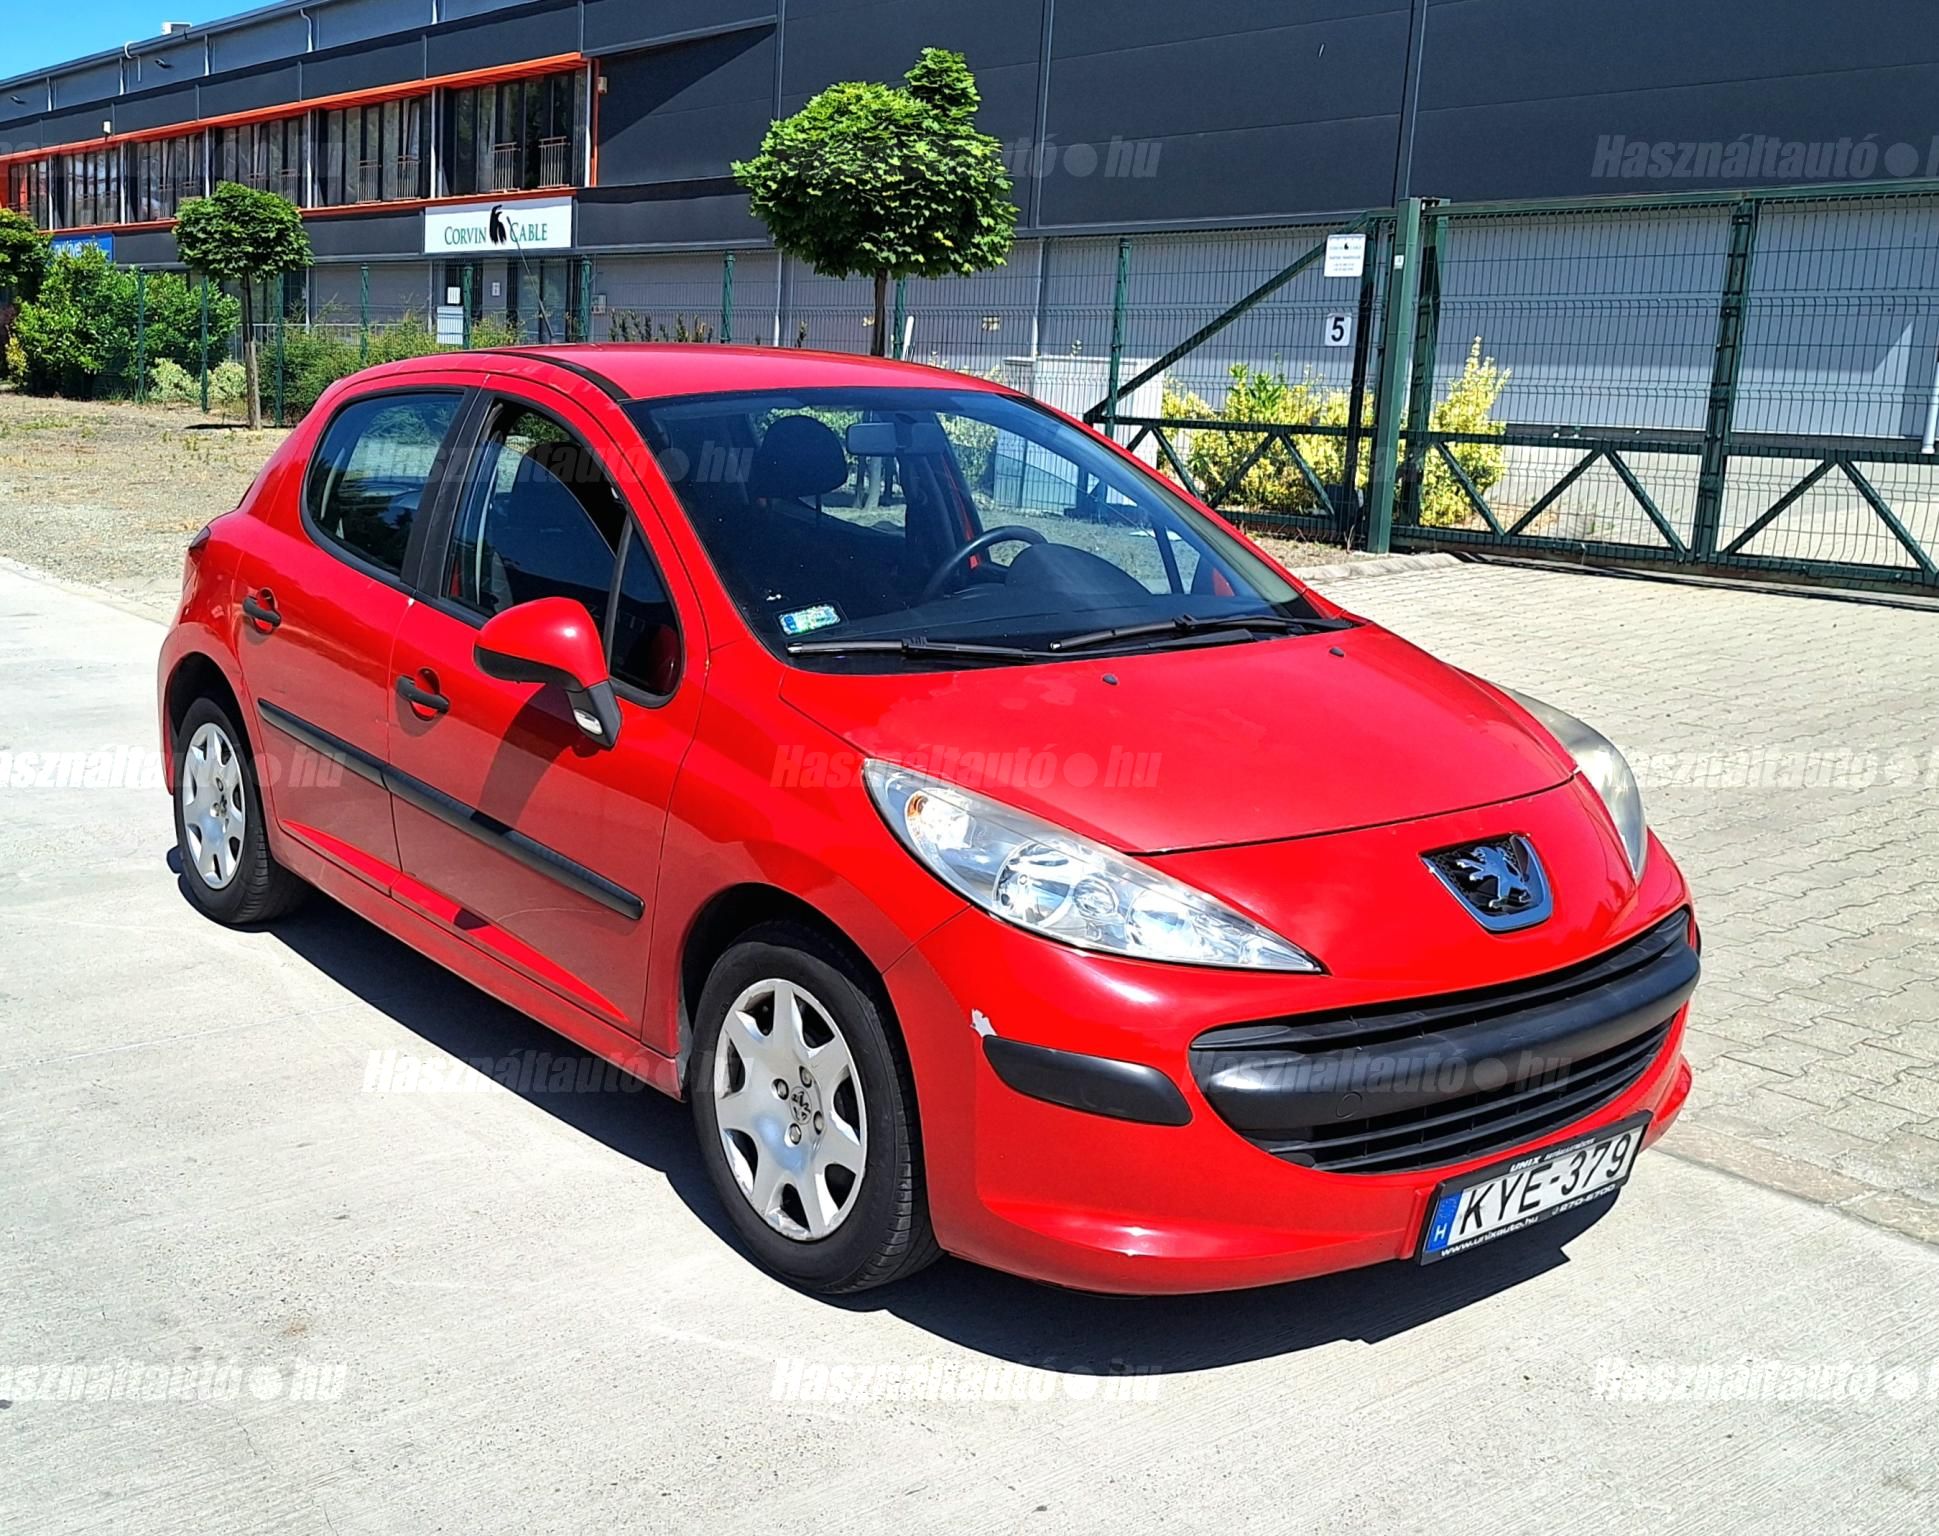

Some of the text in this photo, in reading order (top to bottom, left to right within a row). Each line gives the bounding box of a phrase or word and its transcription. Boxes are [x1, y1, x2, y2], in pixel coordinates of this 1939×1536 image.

[444, 222, 548, 246] CORVIN CABLE
[1331, 316, 1345, 342] 5
[1460, 1133, 1632, 1235] KYE-379
[1433, 1223, 1448, 1242] H
